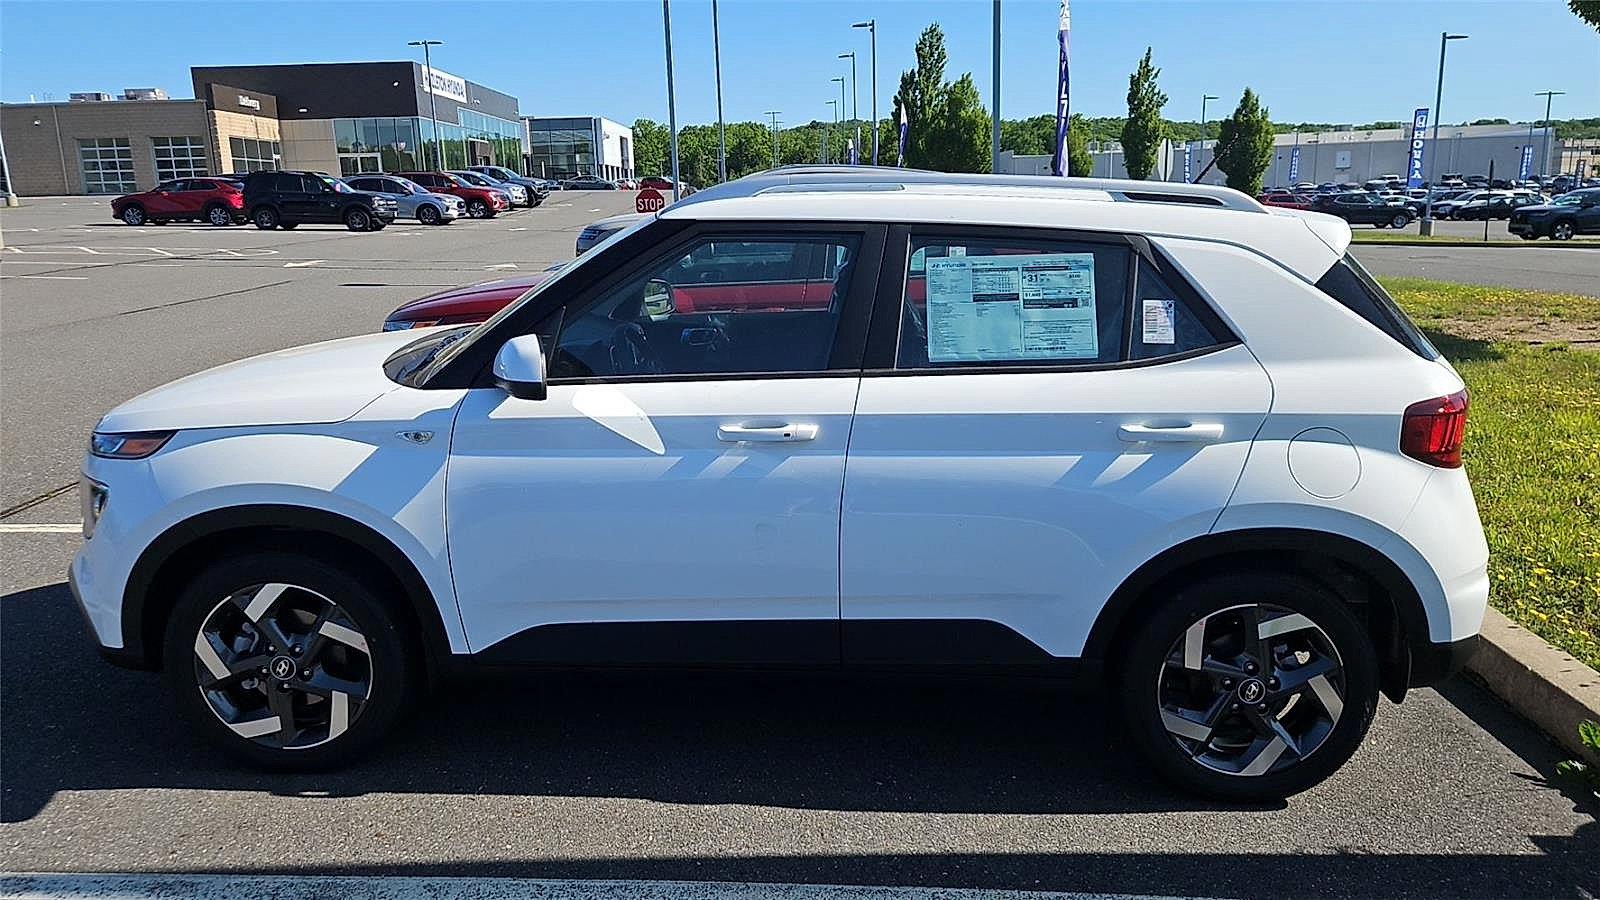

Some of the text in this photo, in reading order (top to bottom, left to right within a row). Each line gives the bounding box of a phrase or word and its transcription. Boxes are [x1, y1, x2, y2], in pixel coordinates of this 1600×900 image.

[1411, 130, 1425, 179] HONDA
[637, 198, 664, 211] STOP
[1027, 274, 1038, 282] 31
